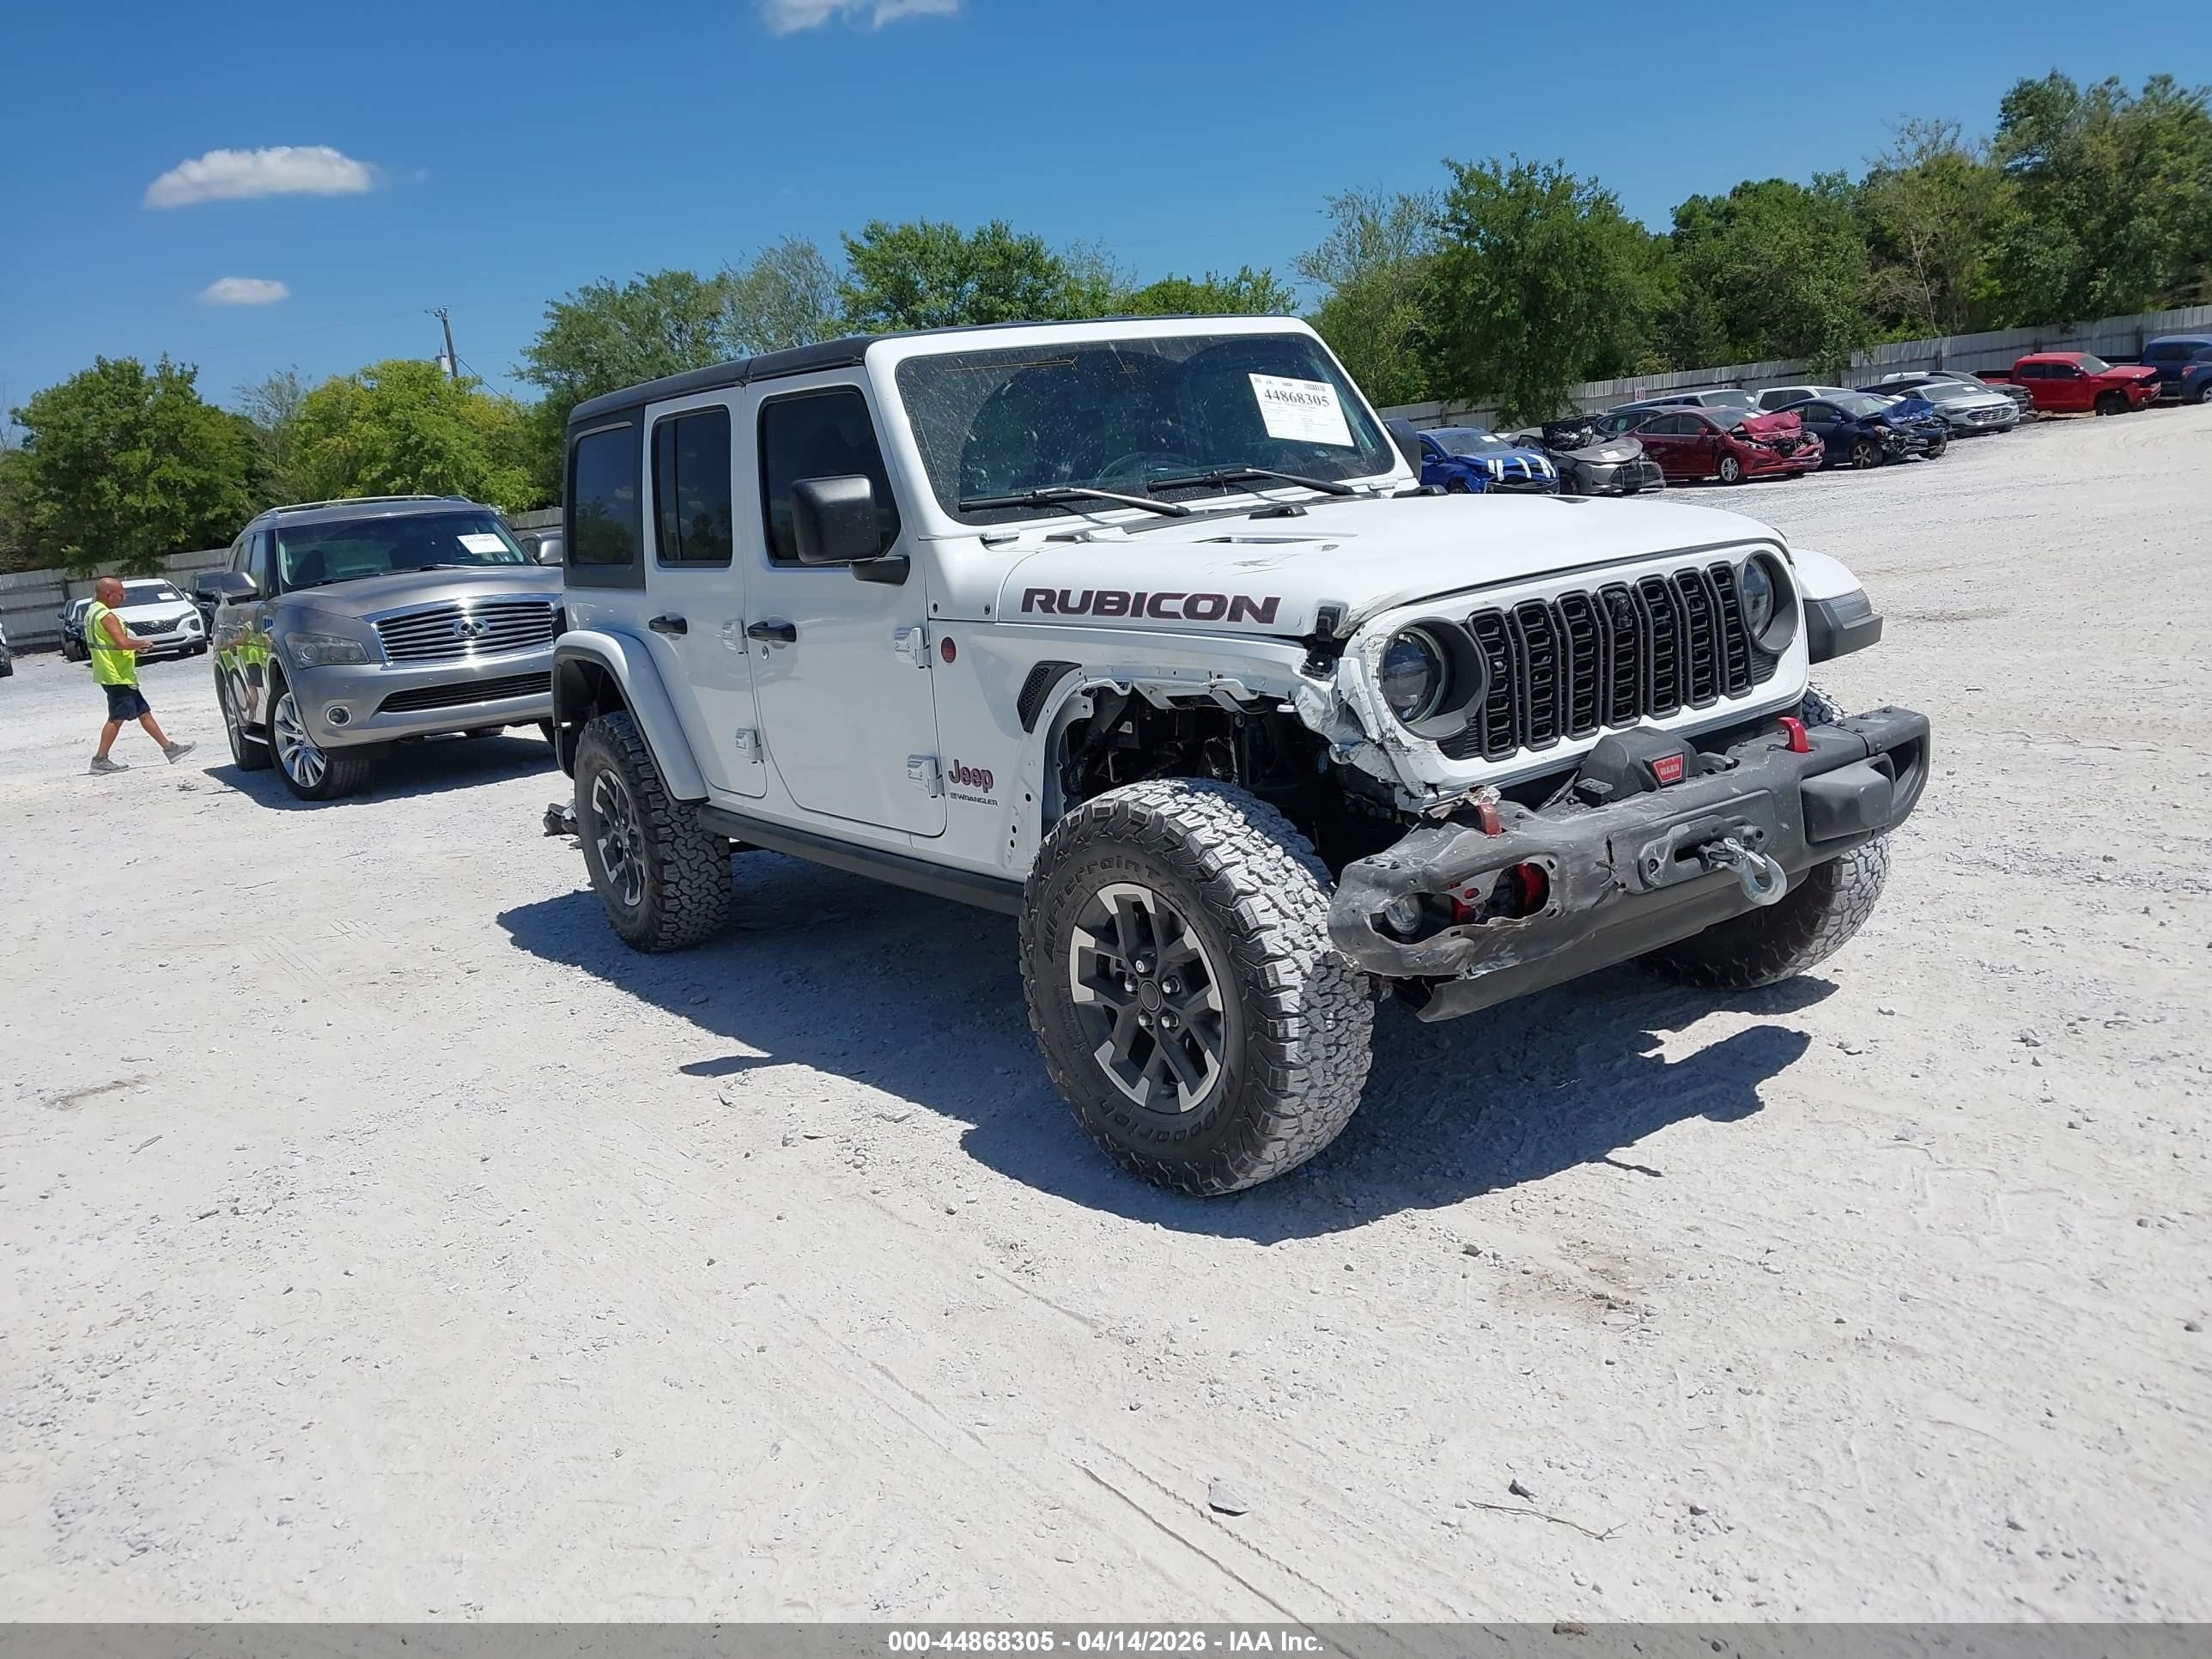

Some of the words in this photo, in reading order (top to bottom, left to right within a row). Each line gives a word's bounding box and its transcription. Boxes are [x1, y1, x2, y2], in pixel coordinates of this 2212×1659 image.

[1264, 388, 1330, 407] 44868305
[1637, 389, 1644, 401] 40
[1020, 587, 1282, 625] RUBICON
[948, 759, 994, 794] Jeep
[957, 793, 999, 806] WRANGLER
